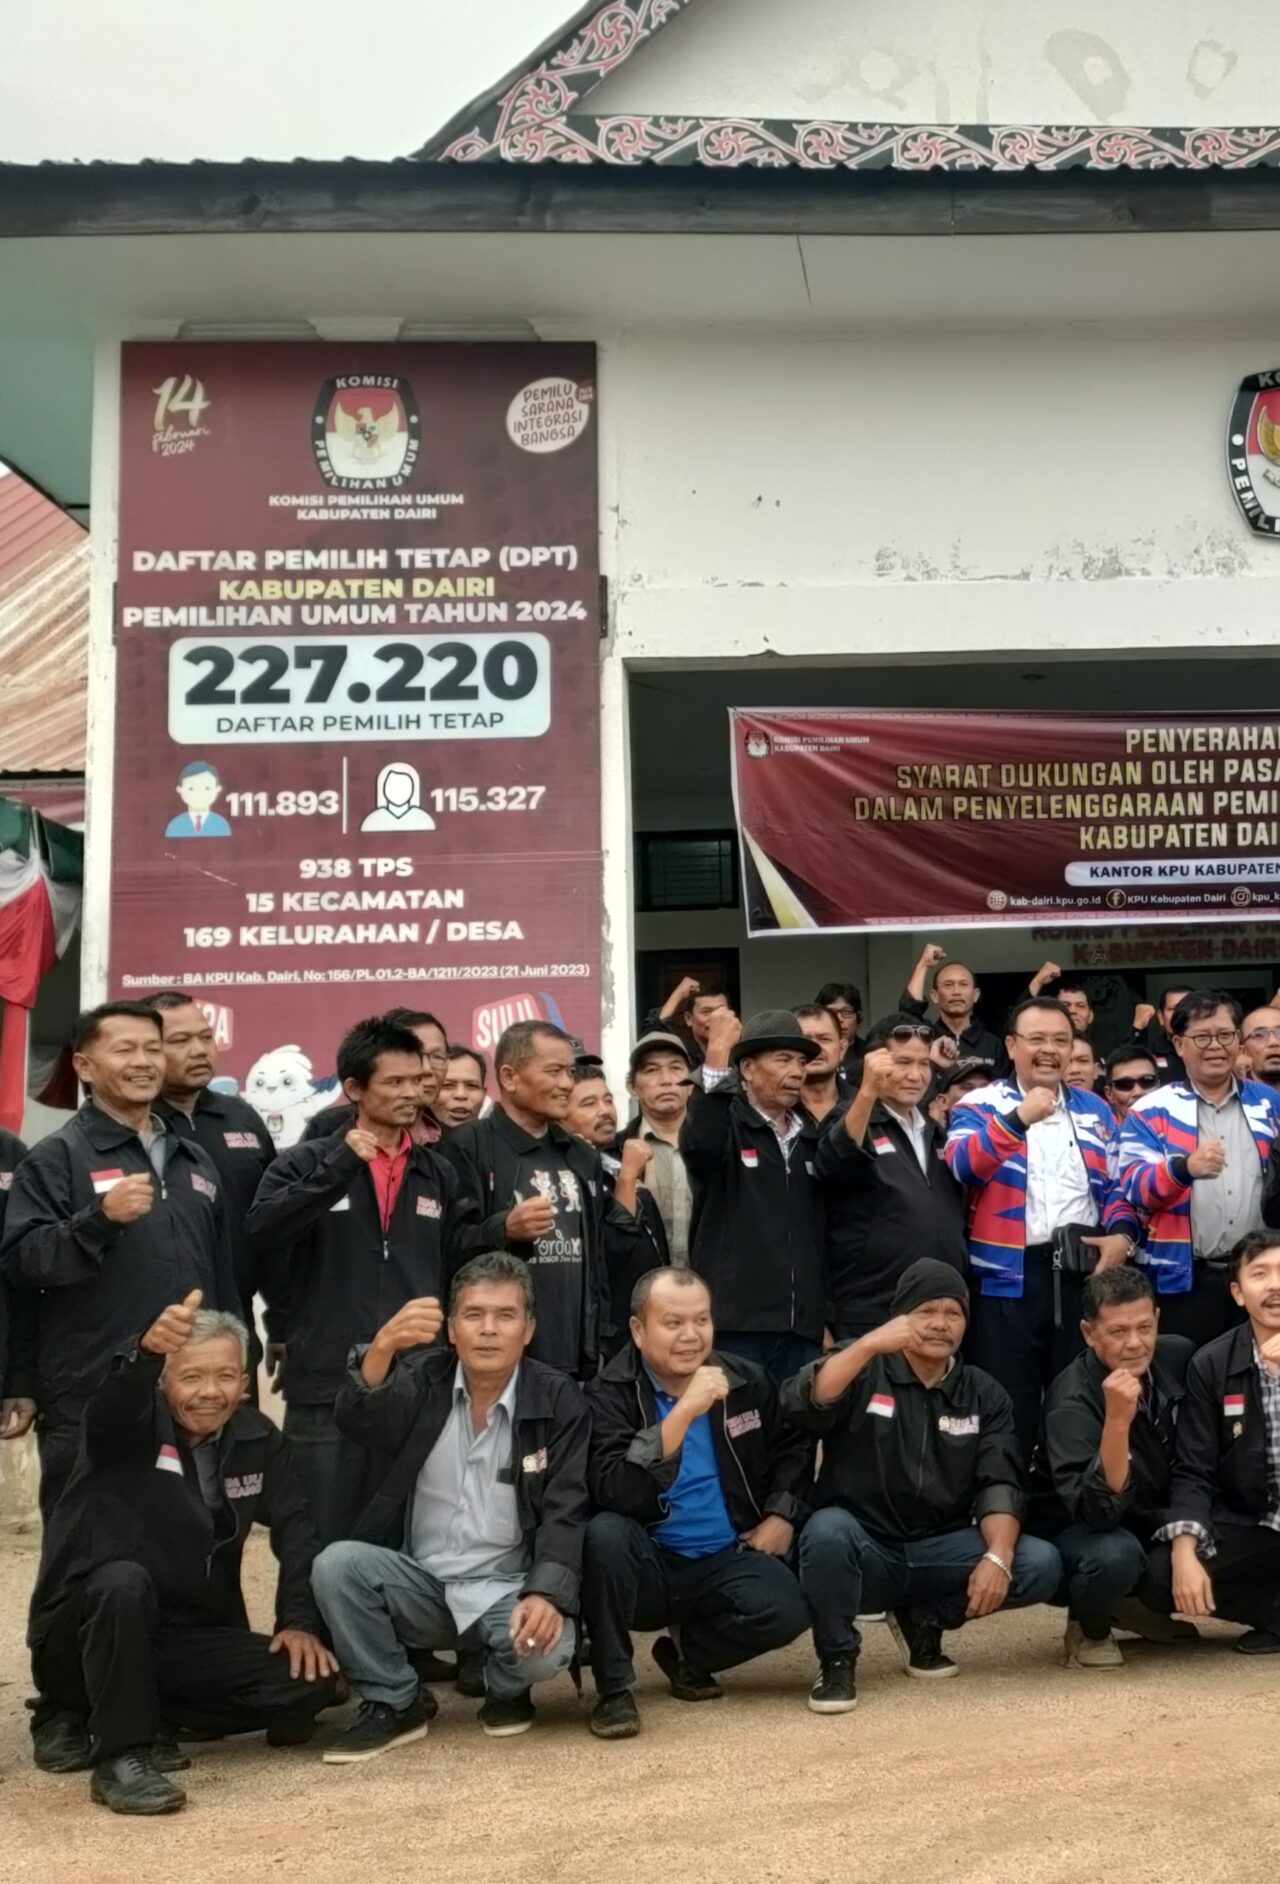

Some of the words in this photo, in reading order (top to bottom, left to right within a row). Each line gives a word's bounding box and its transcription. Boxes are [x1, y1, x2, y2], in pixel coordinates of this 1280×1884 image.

[336, 376, 398, 389] KOMISI
[523, 383, 573, 404] PEMILU
[152, 373, 211, 432] 14
[521, 396, 574, 418] SARANA
[513, 409, 582, 434] INTEGRASI
[161, 438, 195, 457] 2024
[521, 425, 575, 446] BANGSA
[315, 440, 387, 489] PEMILIHAN
[392, 439, 419, 486] UMUM
[269, 494, 324, 507] KOMISI
[328, 494, 413, 506] PEMILIHAN
[415, 493, 464, 506] UMUM
[297, 508, 391, 521] KABUPATEN
[395, 507, 437, 520] DAIRI
[132, 550, 256, 572] DAFTAR
[265, 549, 388, 570] PEMILIH
[396, 547, 491, 569] TETAP
[499, 545, 578, 571] (DPT)
[219, 578, 403, 601] KABUPATEN
[412, 577, 495, 598] DAIRI
[123, 606, 292, 628] PEMILIHAN
[302, 604, 396, 626] UMUM
[404, 602, 508, 624] TAHUN
[515, 601, 587, 622] 2024
[182, 640, 539, 706] 227.220
[216, 716, 314, 734] DAFTAR
[323, 714, 421, 732] PEMILIH
[428, 712, 505, 730] TETAP
[896, 763, 993, 790] SYARAT
[1000, 761, 1142, 788] DUKUNGAN
[1152, 759, 1215, 786] OLEH
[225, 790, 339, 817] 111.893
[430, 786, 546, 813] 115.327
[854, 796, 943, 822] DALAM
[953, 790, 1204, 821] PENYELENGGARAAN
[1079, 822, 1228, 850] KABUPATEN
[299, 859, 352, 879] 938
[358, 858, 414, 878] TPS
[1090, 866, 1153, 878] KANTOR
[1158, 865, 1190, 877] KPU
[246, 893, 274, 913] 15
[282, 889, 464, 912] KECAMATAN
[1010, 895, 1101, 906] kab-dairi.kpu.go.id
[1127, 895, 1148, 905] KPU
[1150, 893, 1202, 906] Kabupaten
[1204, 893, 1227, 903] Dairi
[183, 927, 231, 948] 169
[239, 923, 419, 947] KELURAHAN
[425, 919, 439, 945] /
[446, 920, 525, 942] DESA
[1073, 940, 1213, 965] KABUPATEN
[122, 974, 174, 986] Sumber
[183, 973, 202, 984] BA
[205, 972, 234, 984] KPU
[236, 971, 265, 983] Kab.
[303, 970, 326, 982] No:
[500, 965, 519, 979] (21
[521, 964, 549, 976] Juni
[550, 963, 591, 977] 2023)
